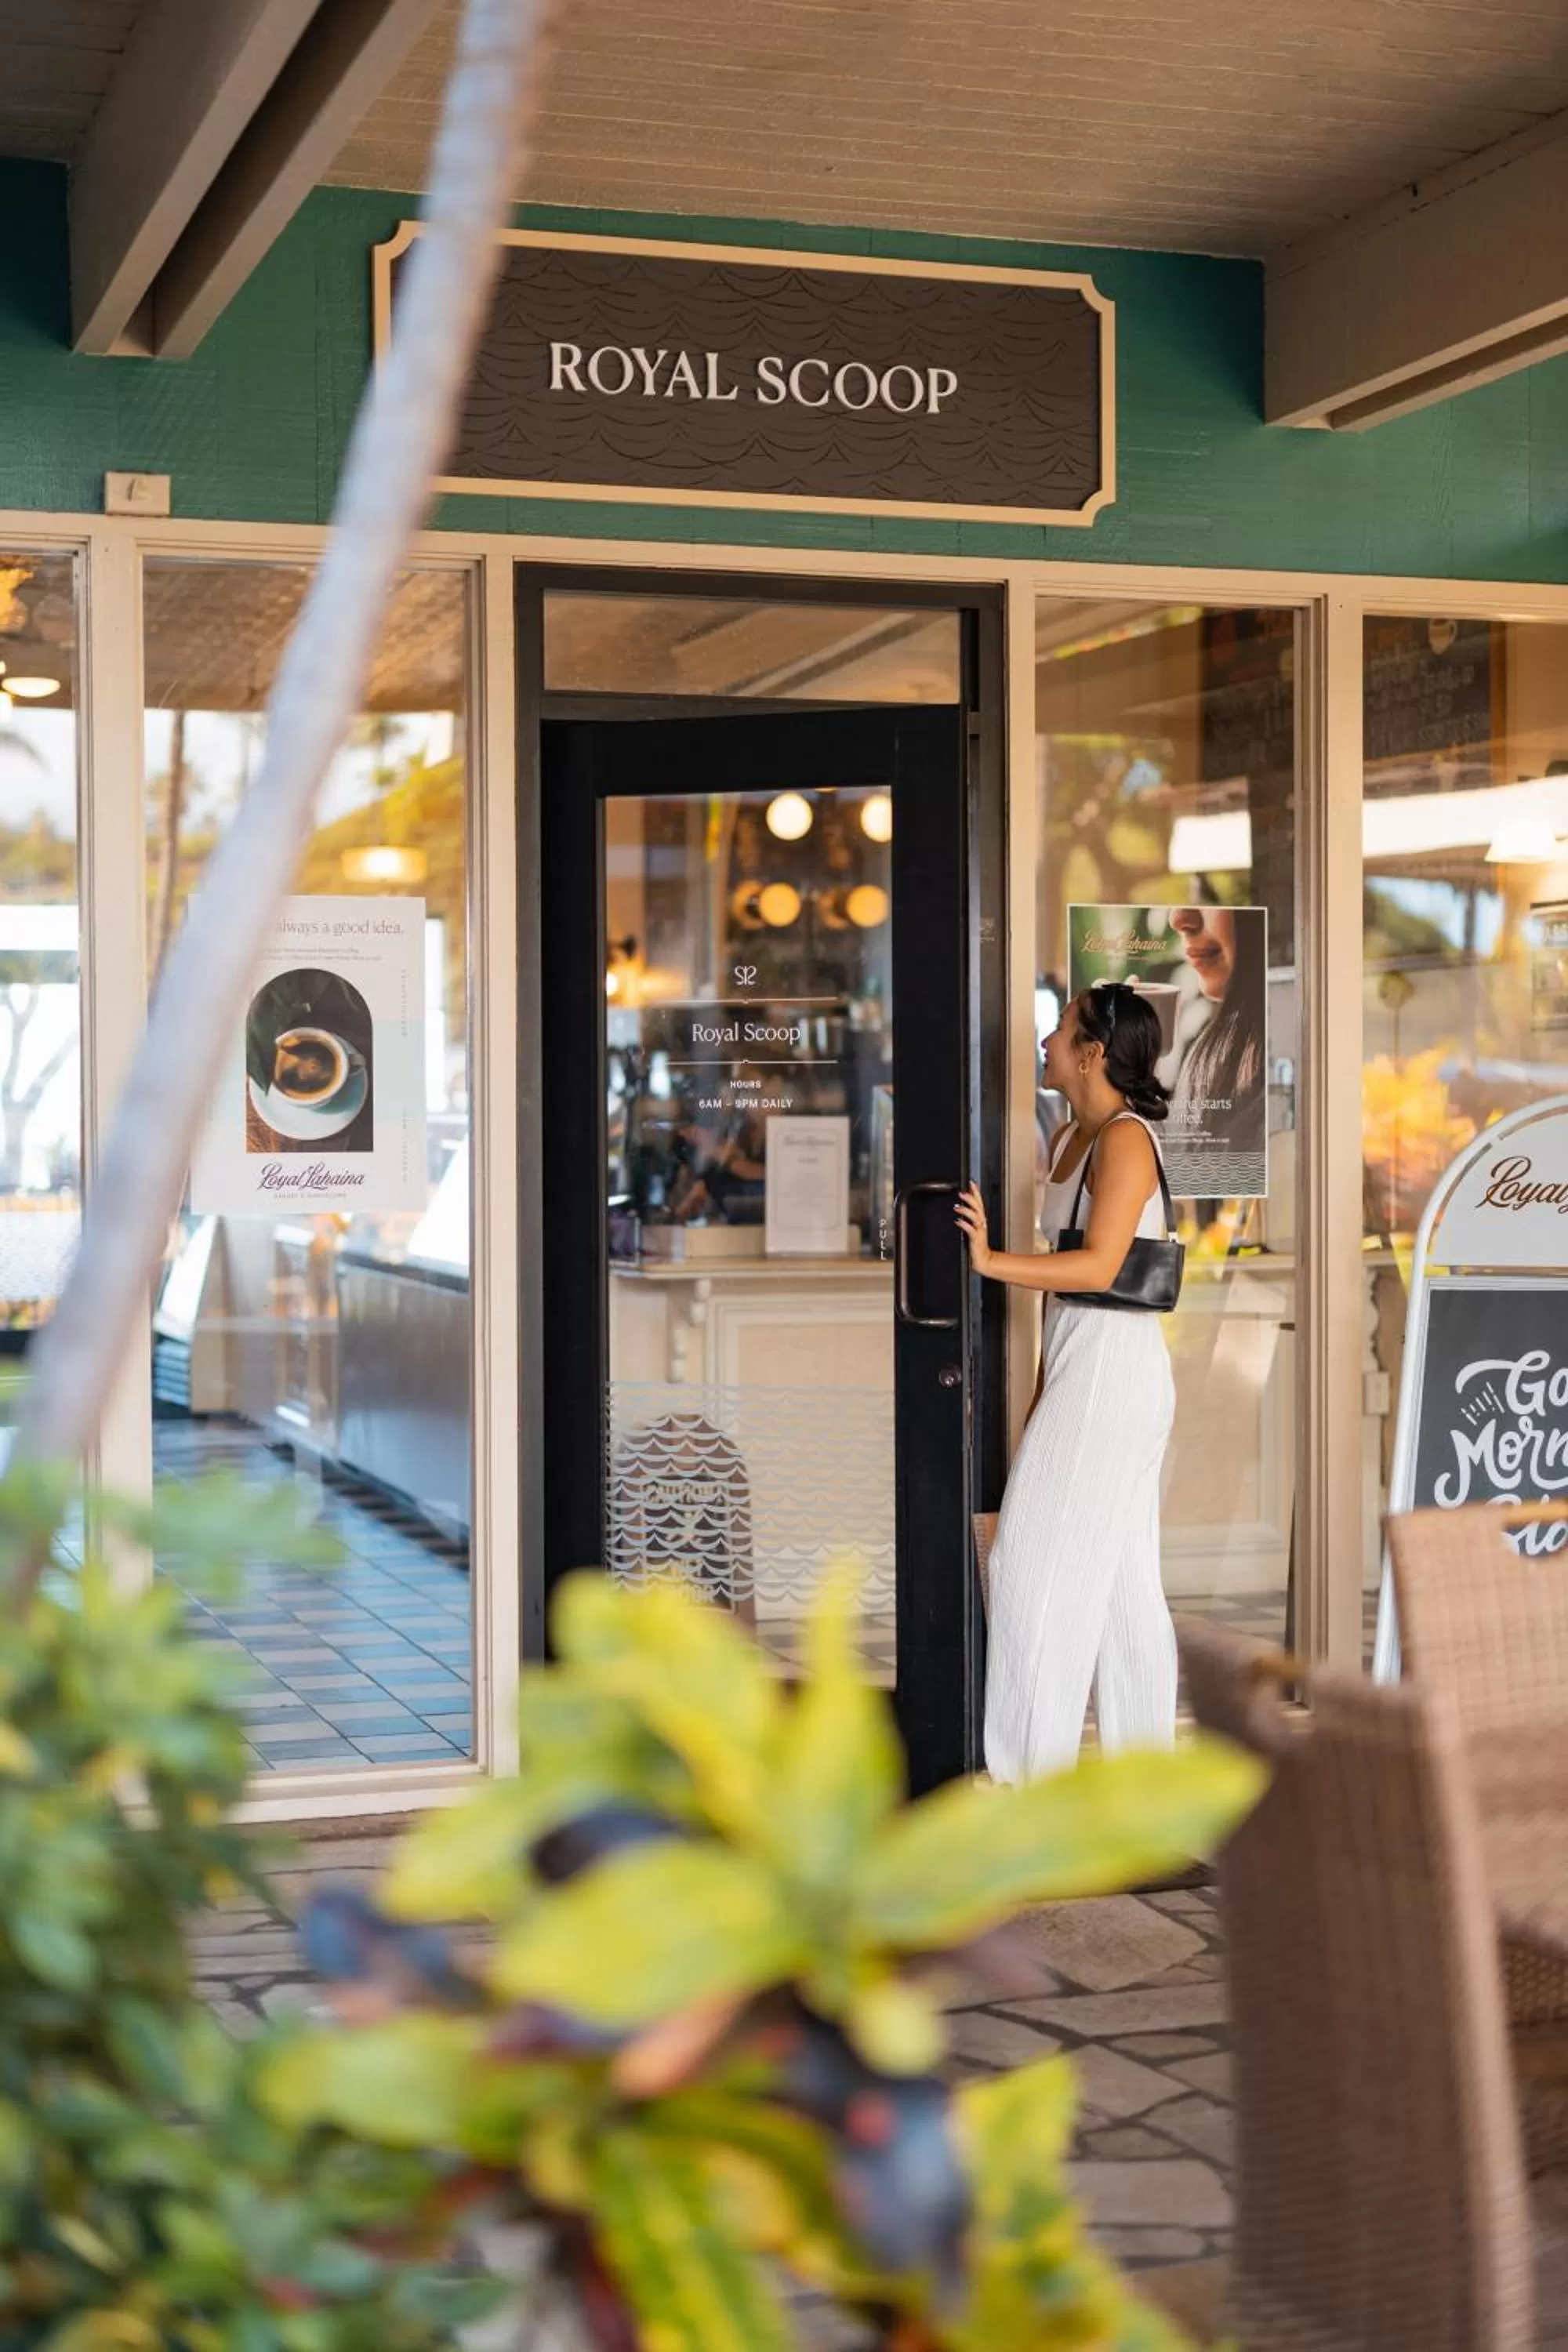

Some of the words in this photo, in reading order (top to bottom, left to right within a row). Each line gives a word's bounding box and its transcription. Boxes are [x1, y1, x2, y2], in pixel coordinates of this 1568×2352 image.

[550, 342, 739, 401] ROYAL
[756, 356, 958, 415] SCOOP
[322, 922, 331, 934] a
[332, 918, 369, 937] good
[691, 1022, 739, 1047] Royal
[744, 1022, 800, 1046] Scoop
[730, 1080, 761, 1089] HOURS
[761, 1098, 793, 1109] DAILY
[1200, 1098, 1232, 1109] starts
[879, 1218, 887, 1261] PULL
